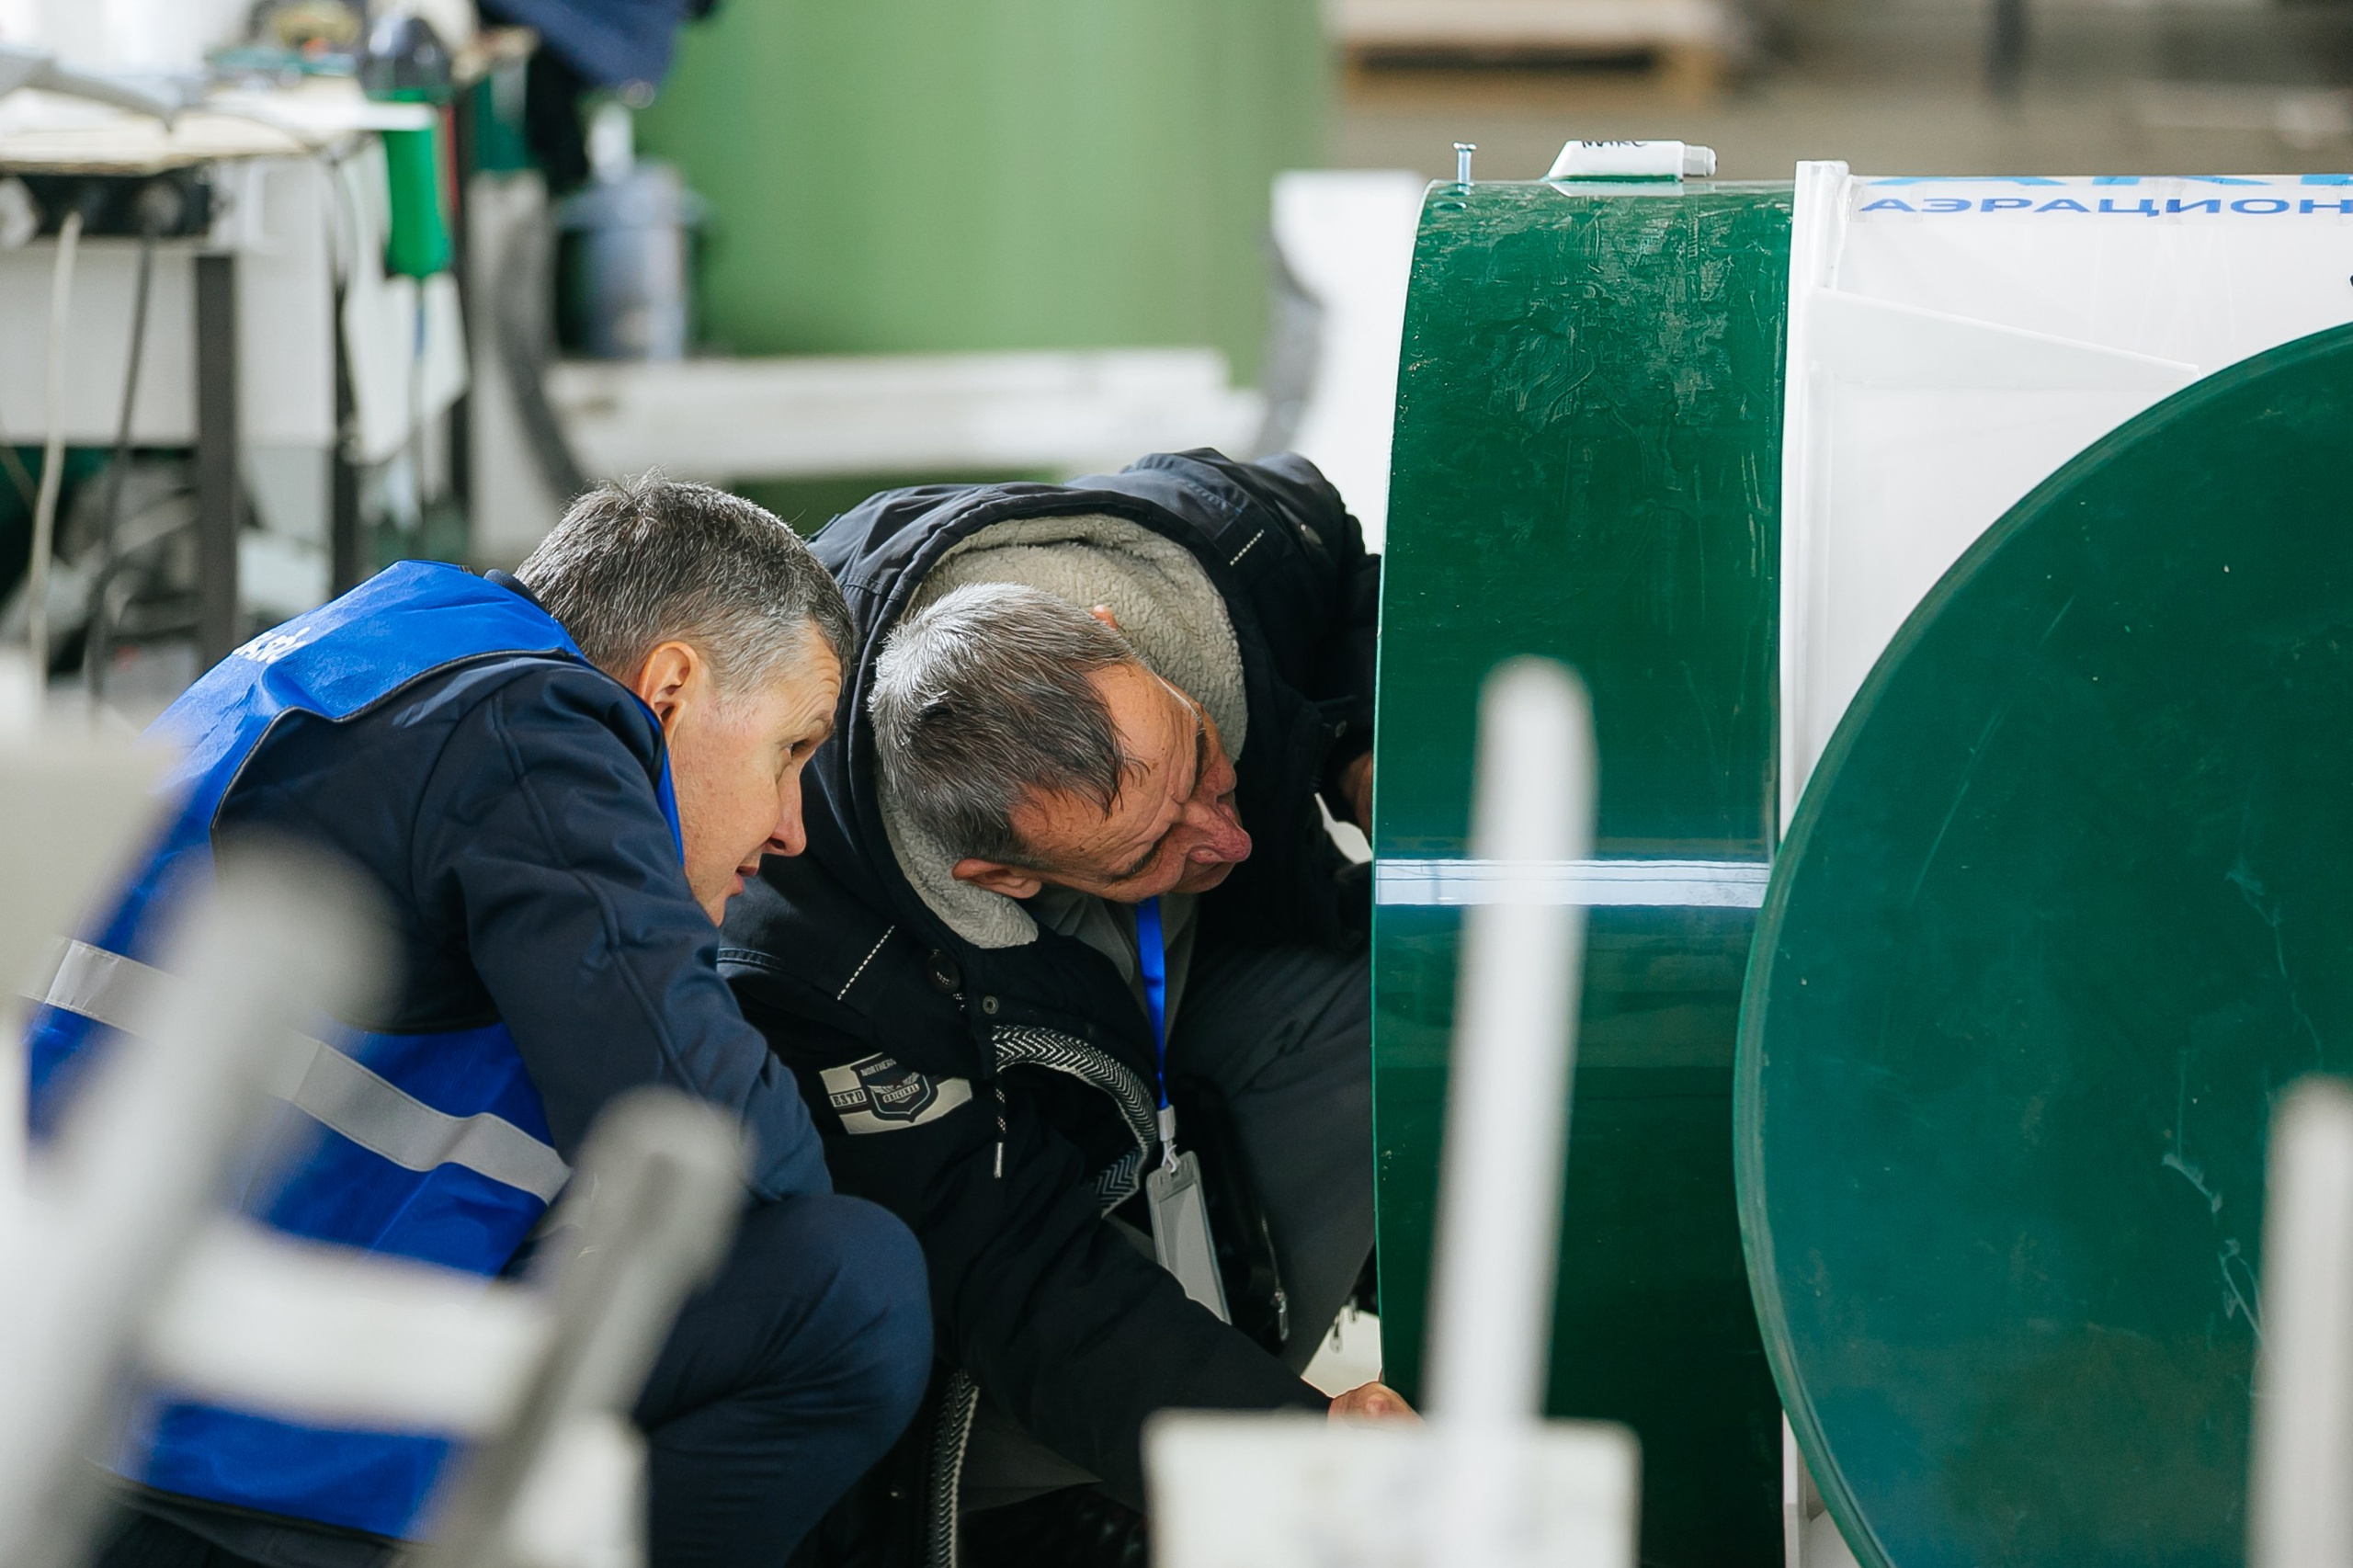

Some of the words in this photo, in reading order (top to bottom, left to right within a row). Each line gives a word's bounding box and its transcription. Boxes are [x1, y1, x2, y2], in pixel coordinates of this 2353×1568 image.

[1859, 197, 2353, 218] АЭРАЦИОН
[832, 1090, 865, 1106] ESTD
[883, 1084, 918, 1102] ORIGINAL
